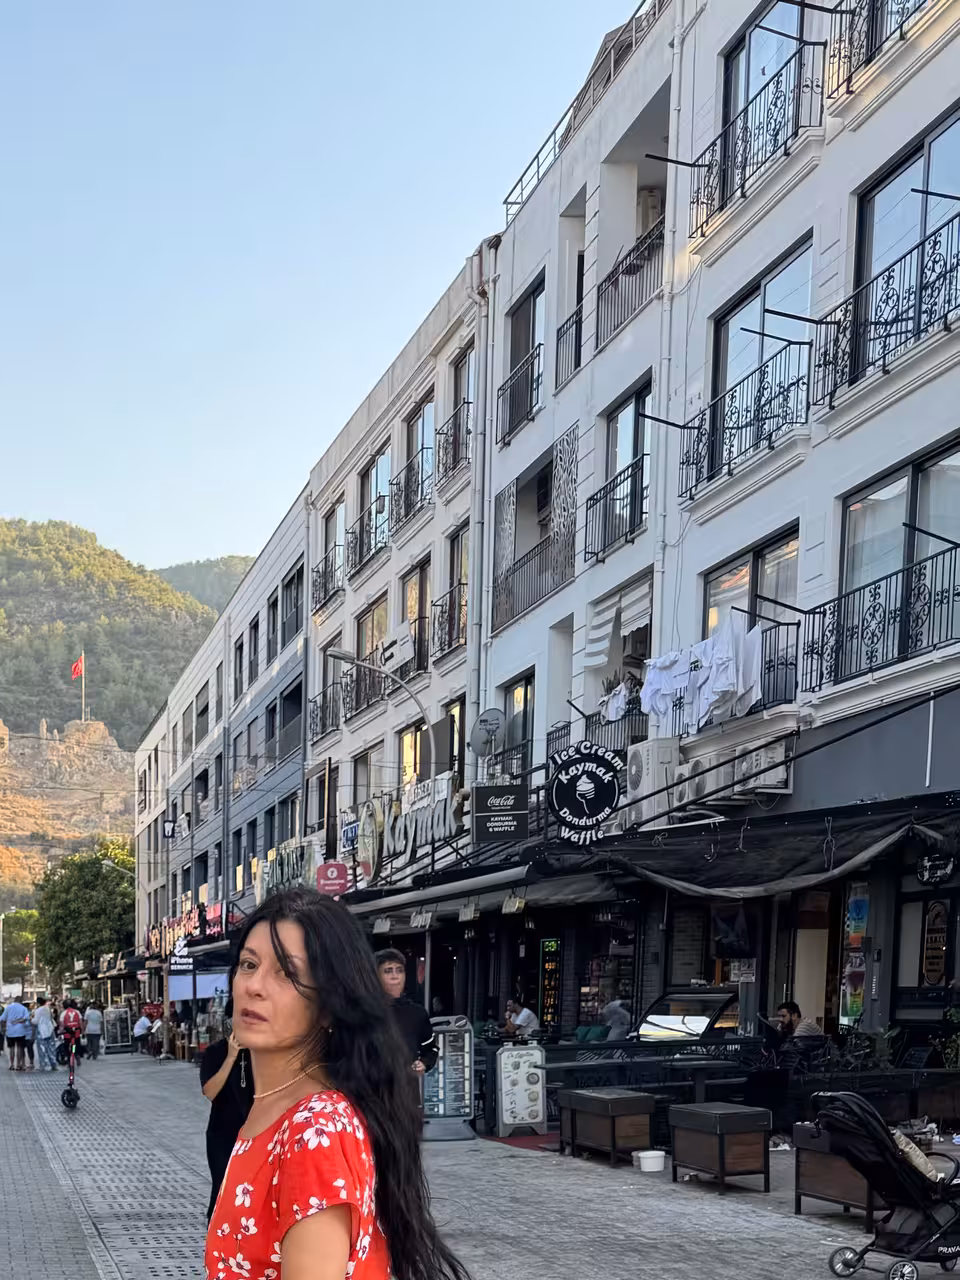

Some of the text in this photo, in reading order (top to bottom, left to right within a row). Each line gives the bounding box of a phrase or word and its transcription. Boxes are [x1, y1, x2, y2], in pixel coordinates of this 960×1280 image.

[554, 744, 576, 765] Ice
[580, 740, 626, 771] Cream
[558, 762, 615, 785] Kaymak
[382, 783, 459, 864] Kaymak
[559, 806, 612, 827] Dondurma
[560, 826, 605, 846] Waffle
